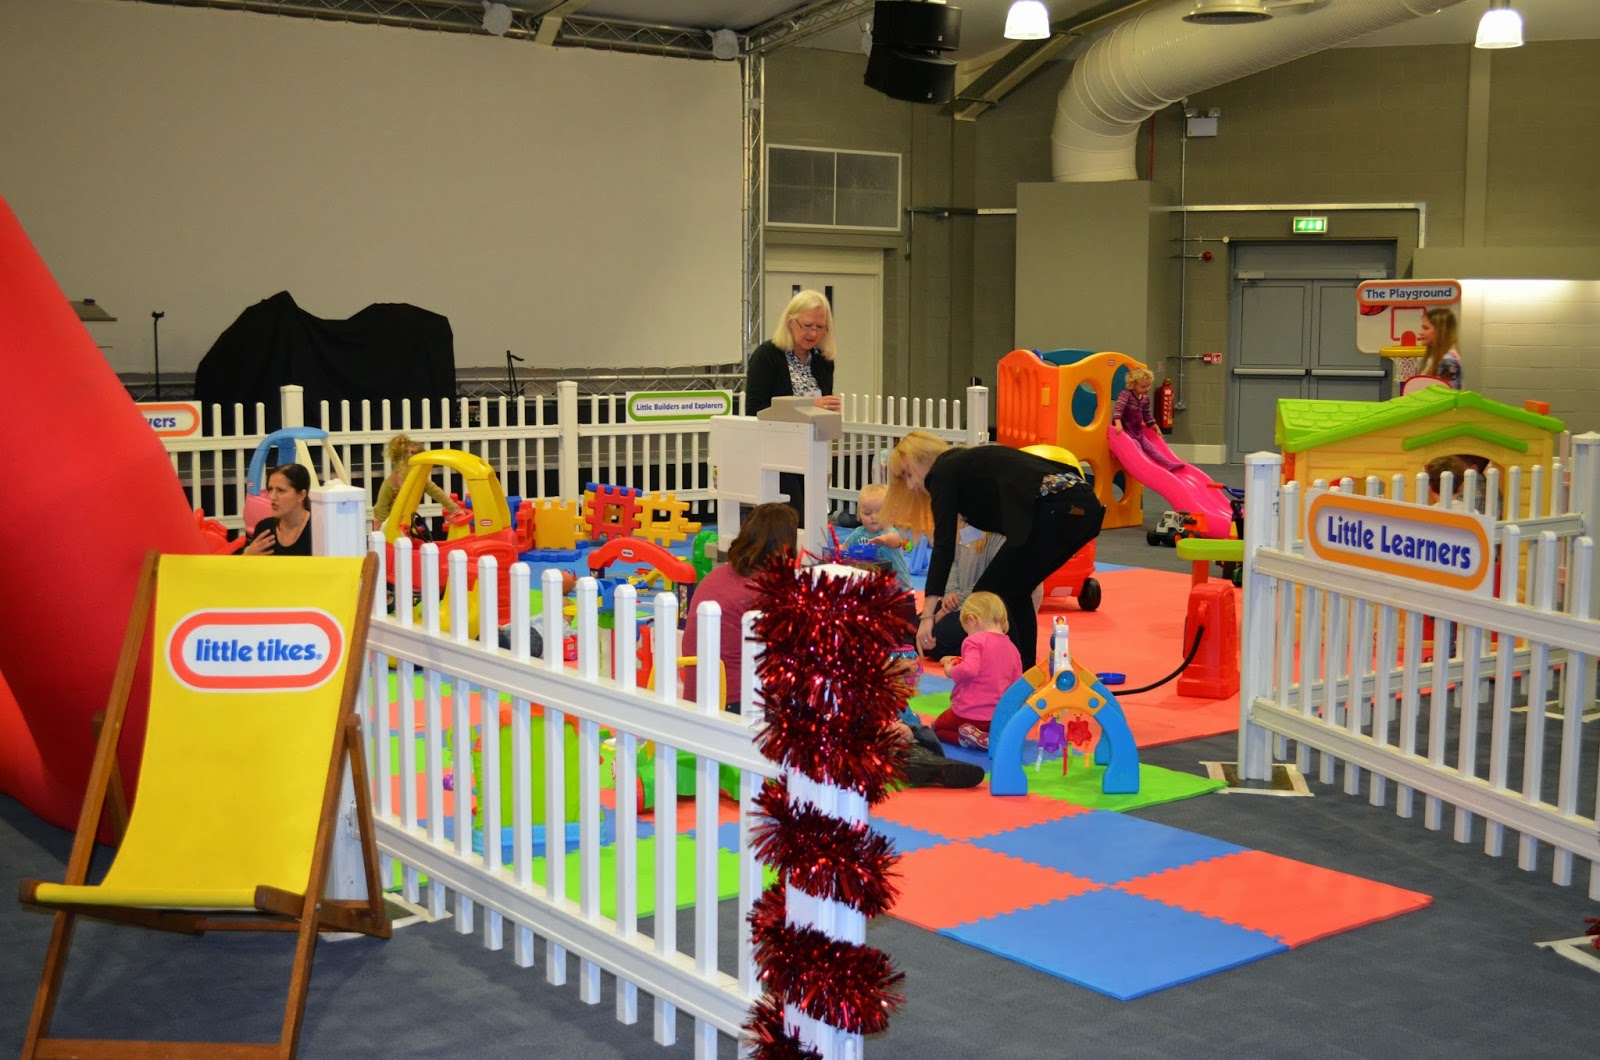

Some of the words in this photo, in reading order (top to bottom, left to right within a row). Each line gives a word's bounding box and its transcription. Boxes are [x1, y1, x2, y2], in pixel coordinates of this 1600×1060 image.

[1366, 289, 1385, 299] The
[1389, 288, 1452, 300] Playground
[636, 403, 652, 411] Little
[654, 402, 680, 411] Builders
[681, 402, 693, 410] and
[694, 402, 724, 410] Explorers
[1327, 515, 1375, 550] Little
[1380, 525, 1471, 570] Learners
[195, 638, 253, 662] little
